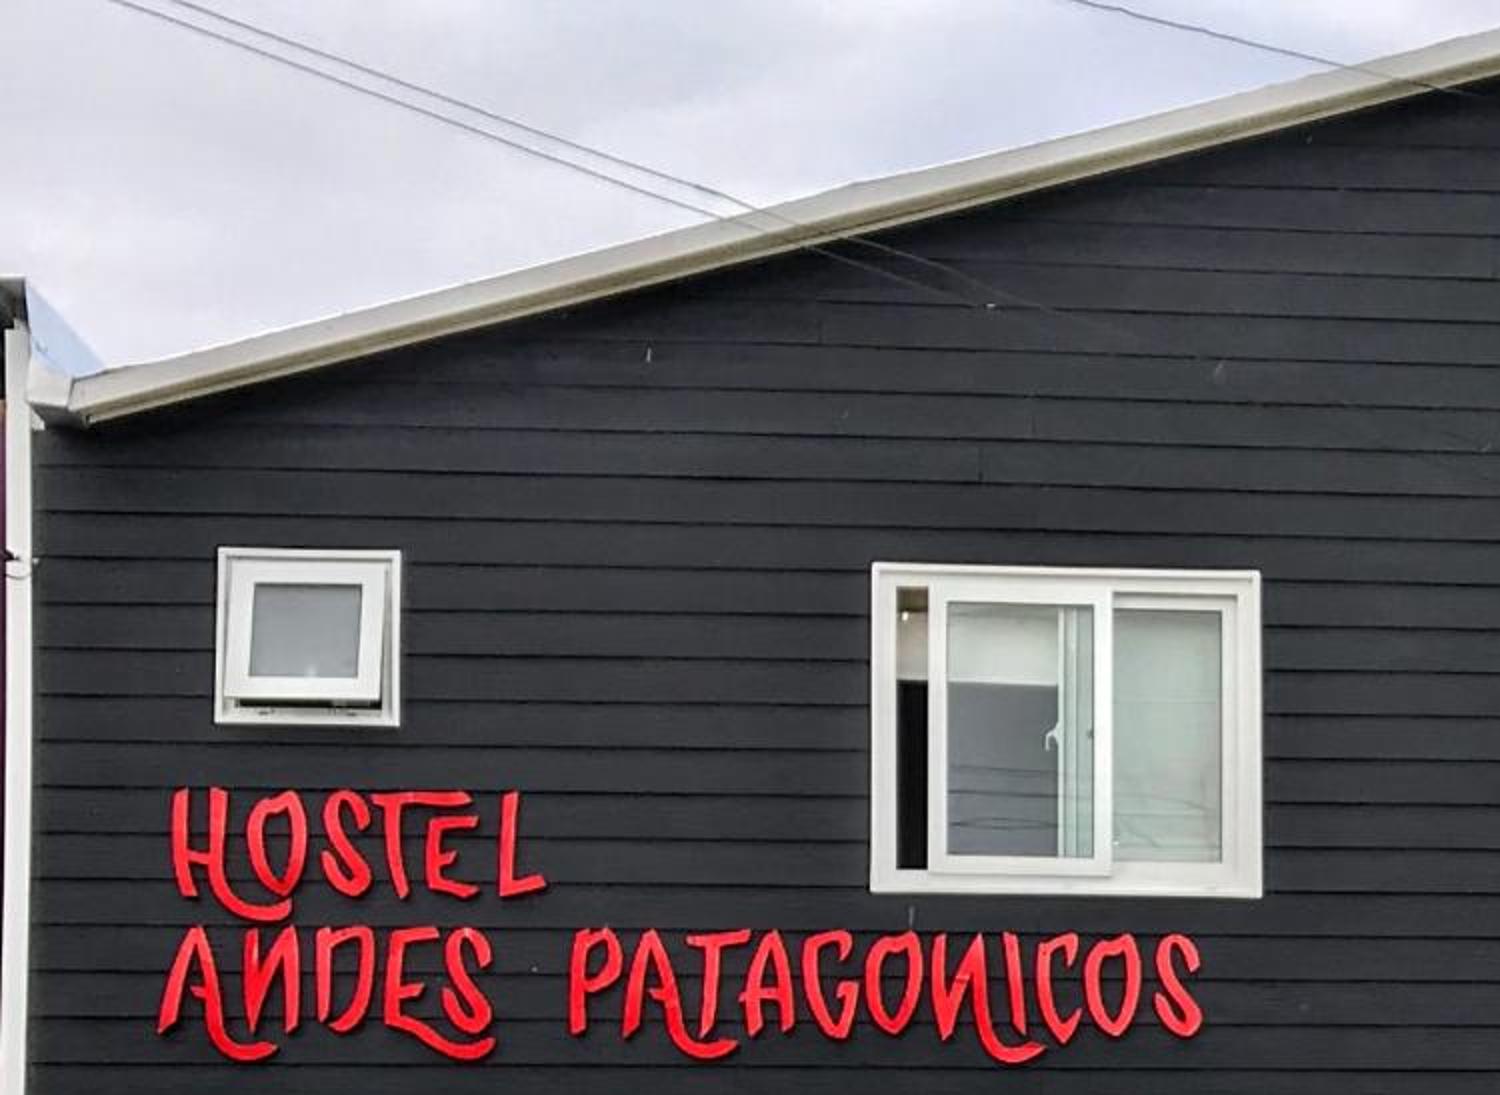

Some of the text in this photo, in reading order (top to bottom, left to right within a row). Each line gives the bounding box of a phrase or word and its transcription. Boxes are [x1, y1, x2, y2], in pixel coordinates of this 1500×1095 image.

[170, 787, 548, 922] HOSTEL
[157, 925, 1204, 1065] ANDES PATAGONICOS
